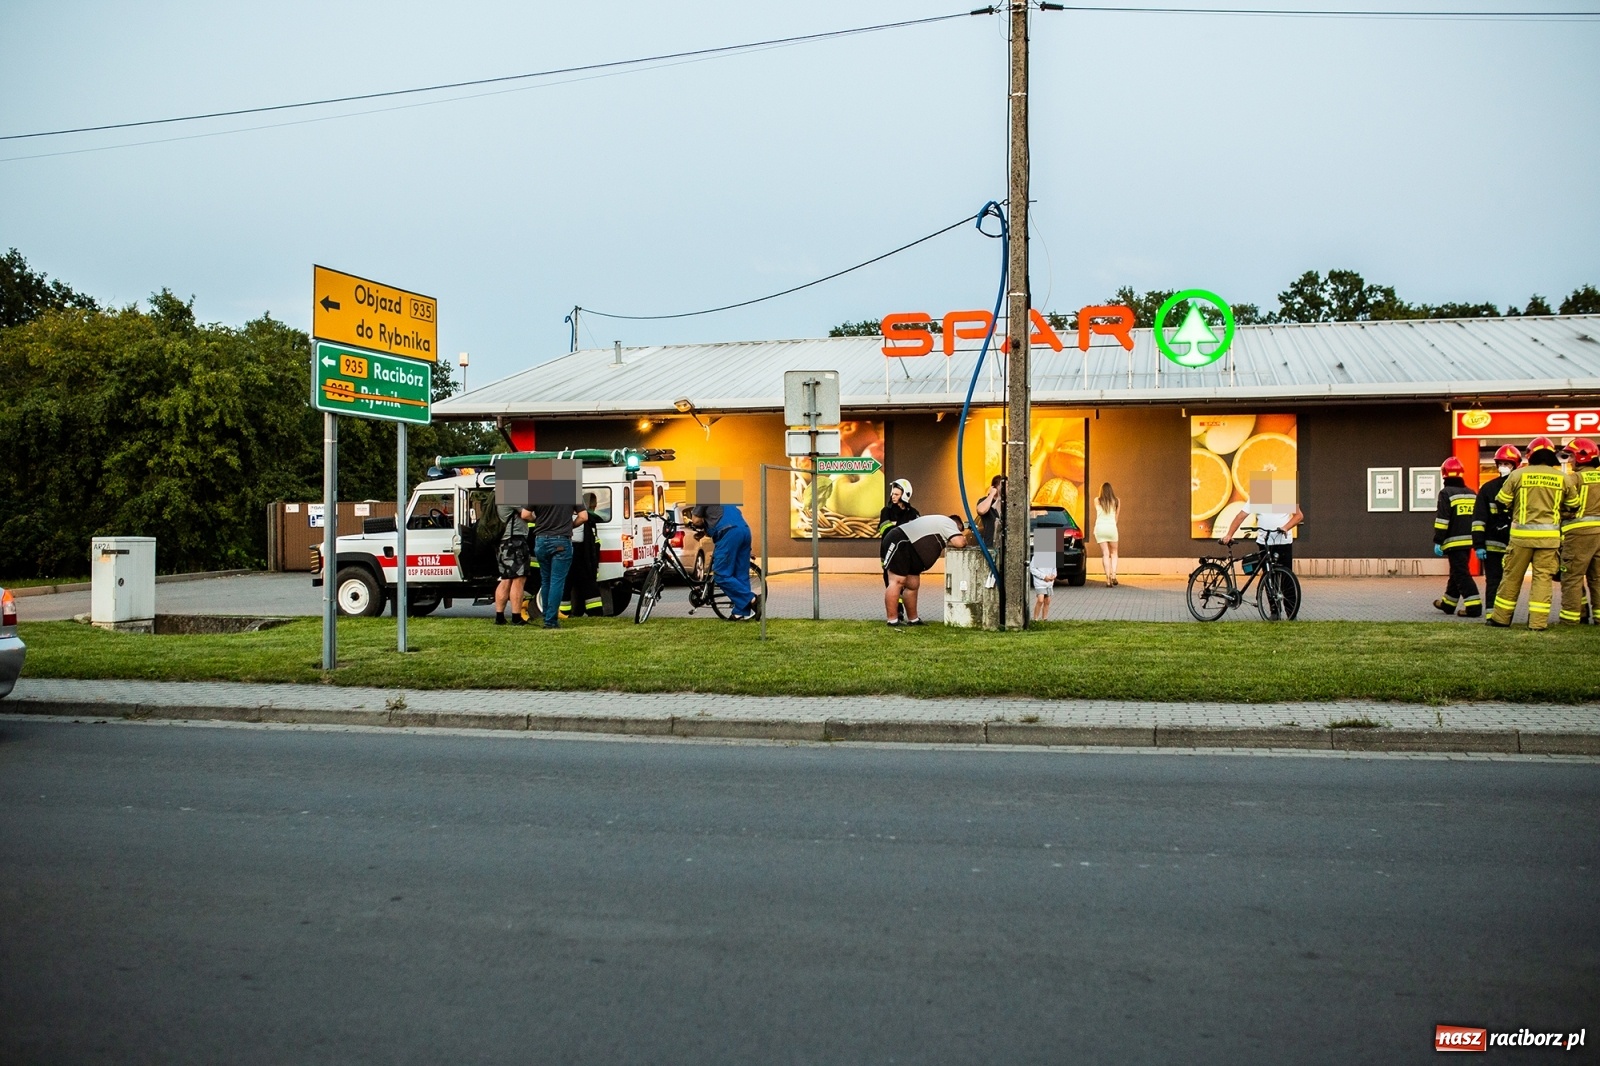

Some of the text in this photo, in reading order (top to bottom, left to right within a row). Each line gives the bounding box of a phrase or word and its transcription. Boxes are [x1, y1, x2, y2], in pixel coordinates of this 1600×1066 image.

[354, 284, 402, 315] Objazd
[412, 302, 432, 319] 935
[356, 318, 431, 352] do Rybnika
[881, 305, 1135, 357] SPAR
[345, 358, 424, 388] 935 Racibórz
[1546, 412, 1600, 432] SP
[818, 460, 875, 471] BANKOMAT
[417, 554, 441, 566] STRAŻ
[420, 567, 453, 576] POGRZEBIEŃ
